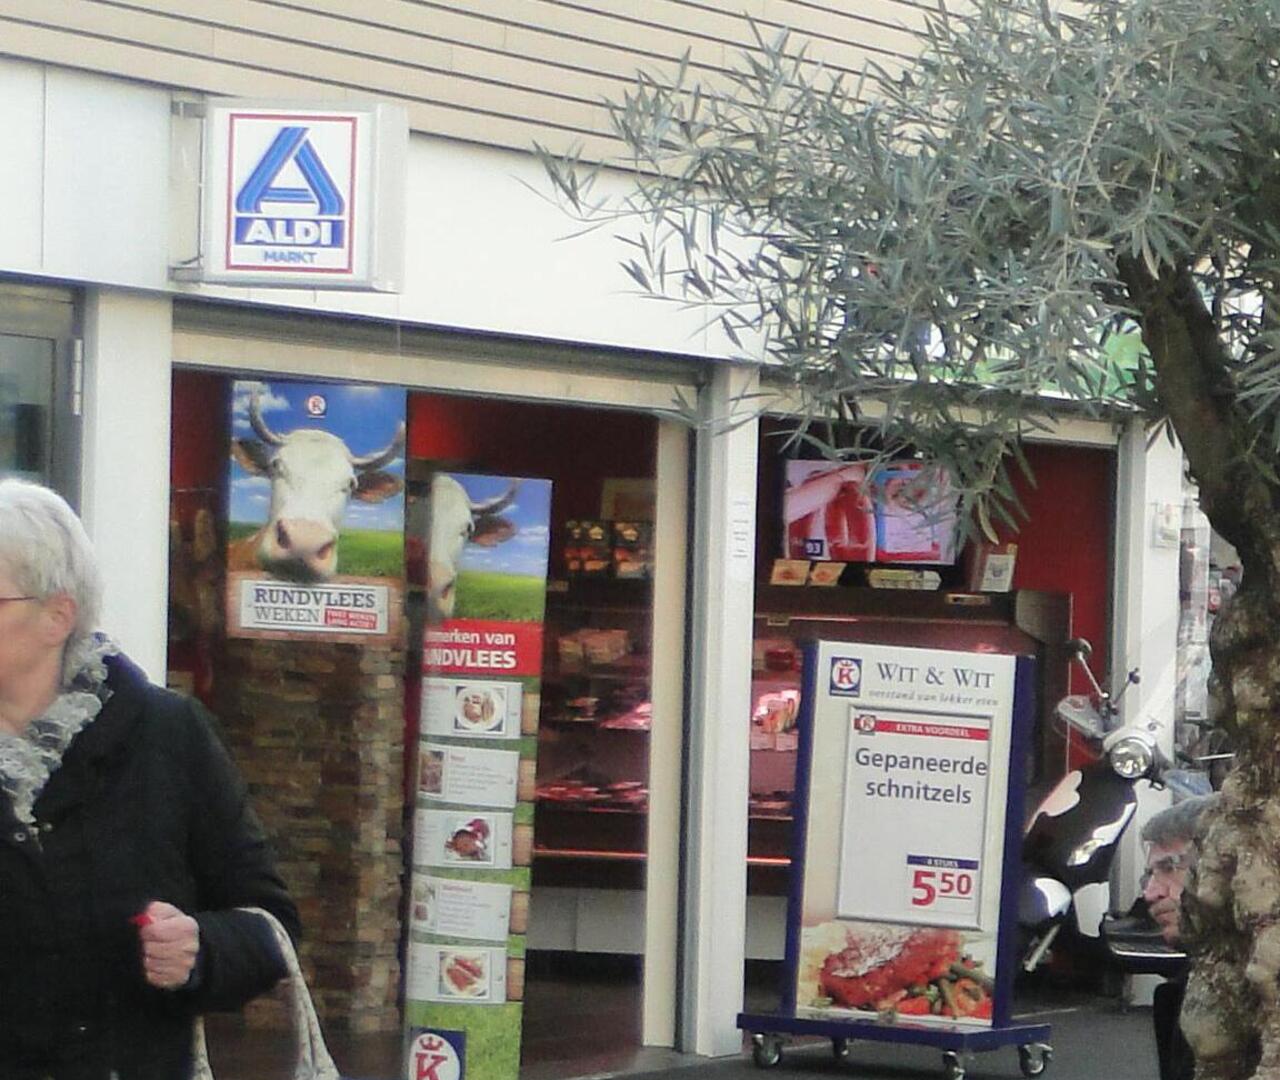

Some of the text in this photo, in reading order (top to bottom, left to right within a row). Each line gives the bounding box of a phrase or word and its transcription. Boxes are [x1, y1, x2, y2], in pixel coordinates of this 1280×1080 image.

[243, 218, 333, 245] ALDI
[264, 250, 317, 264] MARKT
[254, 587, 376, 608] RUNDVLEES
[255, 606, 321, 623] WEKEN
[484, 632, 516, 645] van
[925, 668, 944, 686] &
[896, 723, 924, 733] EXTRA
[855, 747, 988, 777] Gepaneerde
[865, 778, 972, 804] schnitzels
